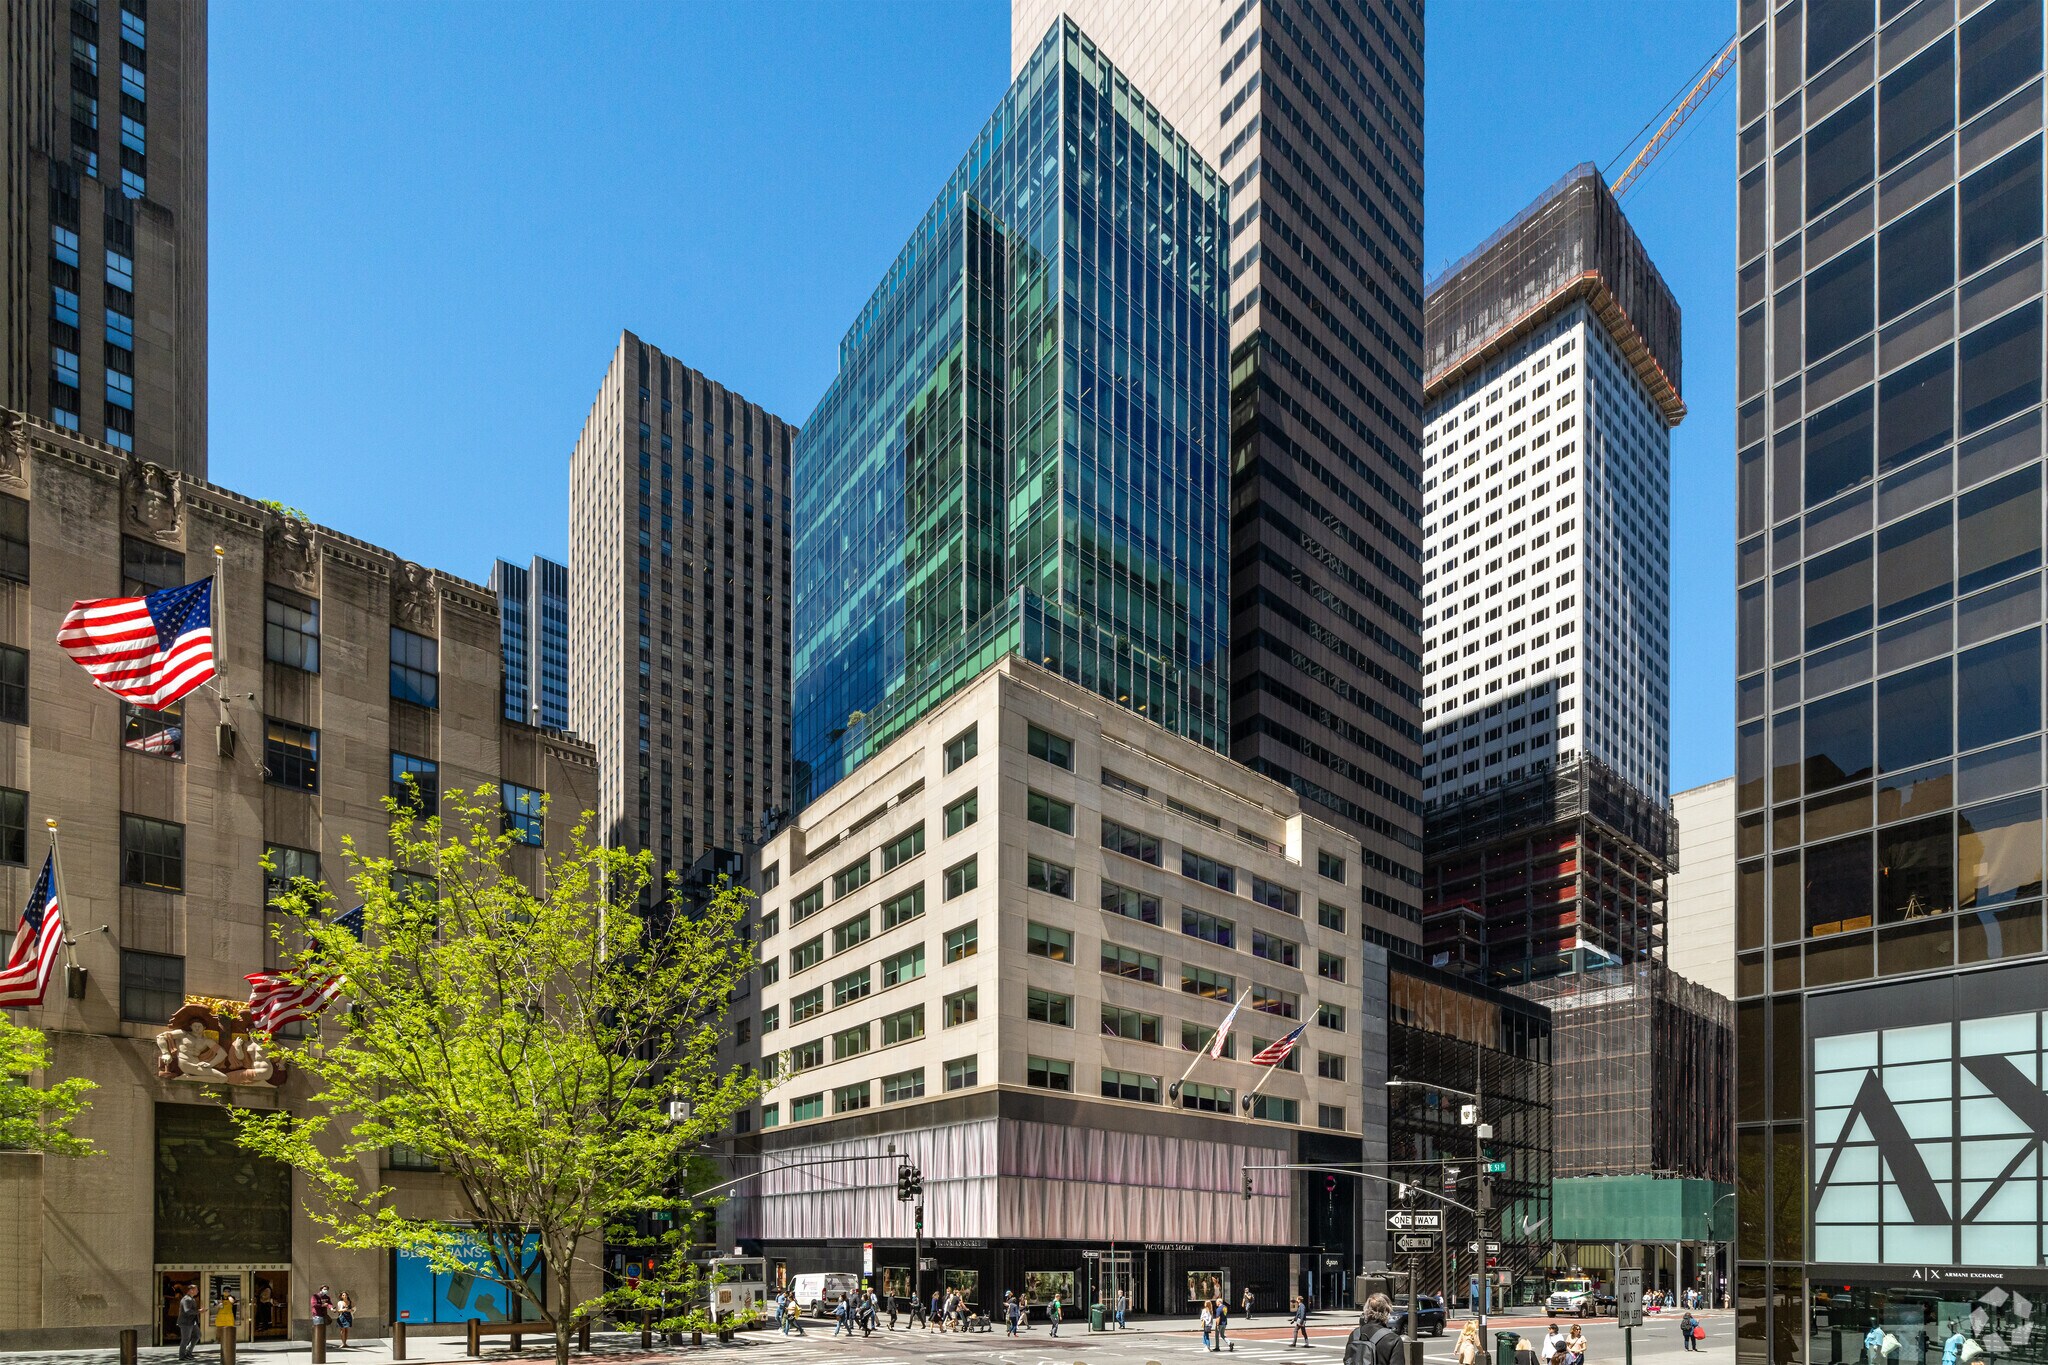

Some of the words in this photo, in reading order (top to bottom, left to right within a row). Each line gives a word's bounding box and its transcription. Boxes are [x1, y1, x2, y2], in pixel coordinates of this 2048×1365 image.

[1494, 1164, 1500, 1172] 51
[1394, 1216, 1410, 1224] ONE
[1417, 1216, 1434, 1224] WAY
[1144, 1243, 1175, 1251] VICTORIA'S
[1401, 1239, 1413, 1247] ONE
[1417, 1239, 1430, 1247] WAY
[1325, 1258, 1338, 1267] dyson
[1620, 1276, 1628, 1285] LEFT
[1629, 1276, 1640, 1285] LANE
[1623, 1292, 1636, 1303] MUST
[1620, 1310, 1630, 1320] TURN
[1631, 1309, 1640, 1319] LEFT
